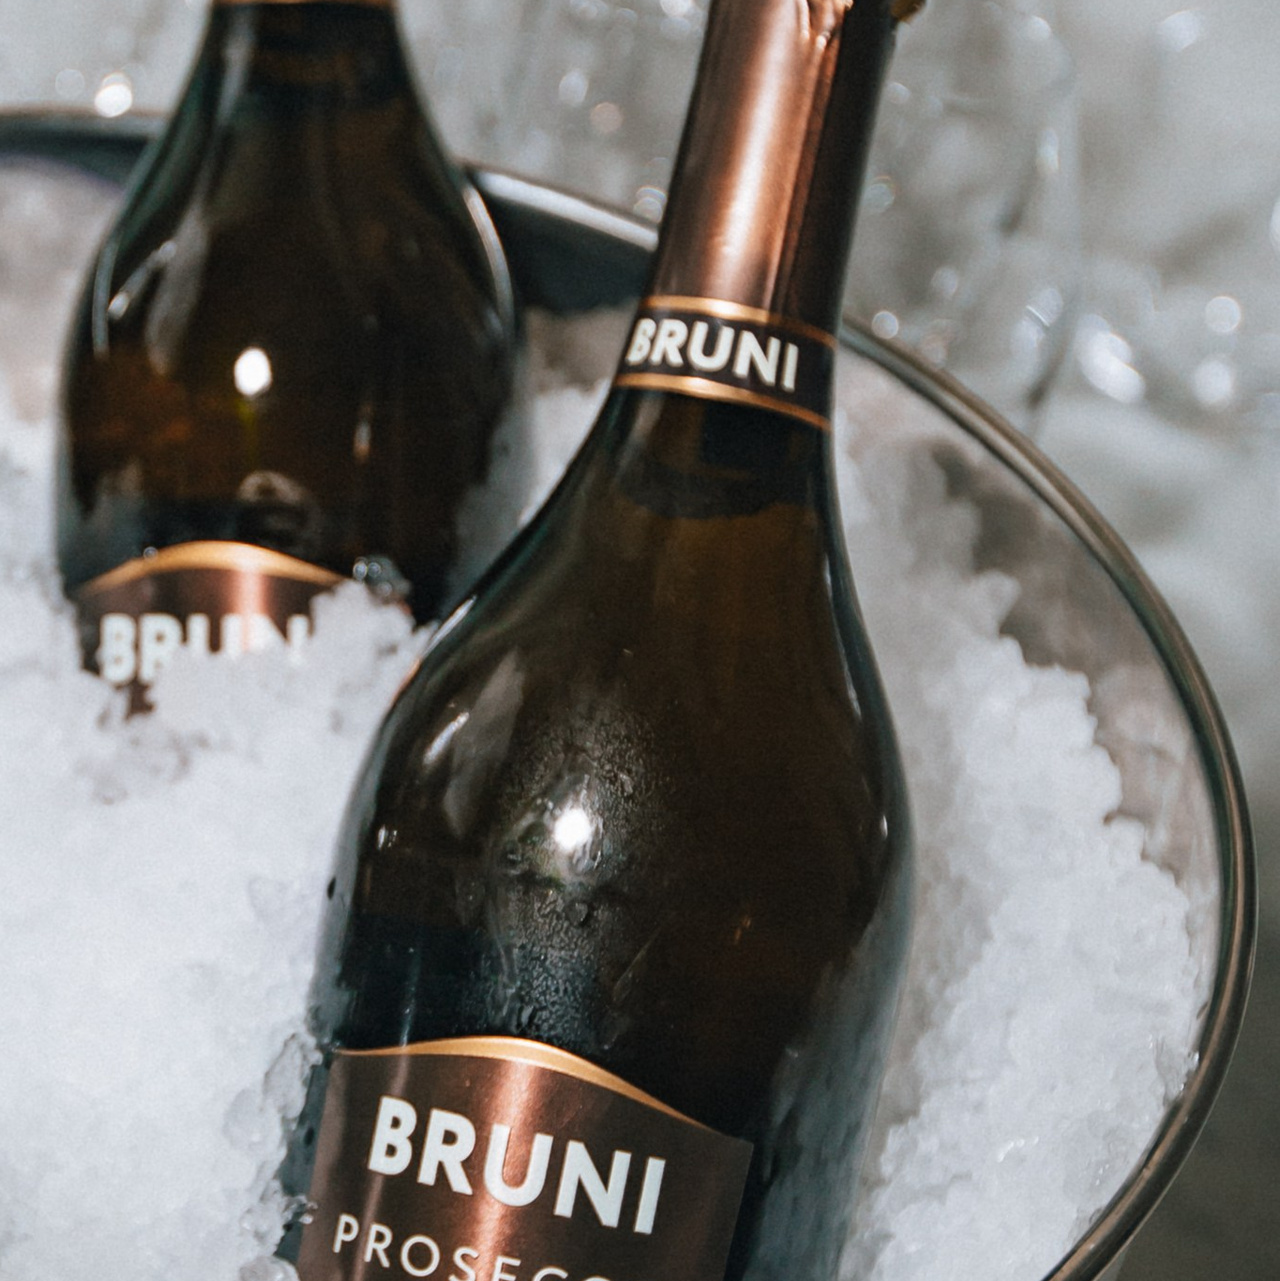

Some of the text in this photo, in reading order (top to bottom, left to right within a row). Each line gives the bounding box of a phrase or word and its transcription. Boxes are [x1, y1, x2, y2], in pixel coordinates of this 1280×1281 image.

[624, 317, 800, 394] BRUNI
[99, 612, 310, 684] BRUN
[367, 1095, 666, 1235] BRUNI
